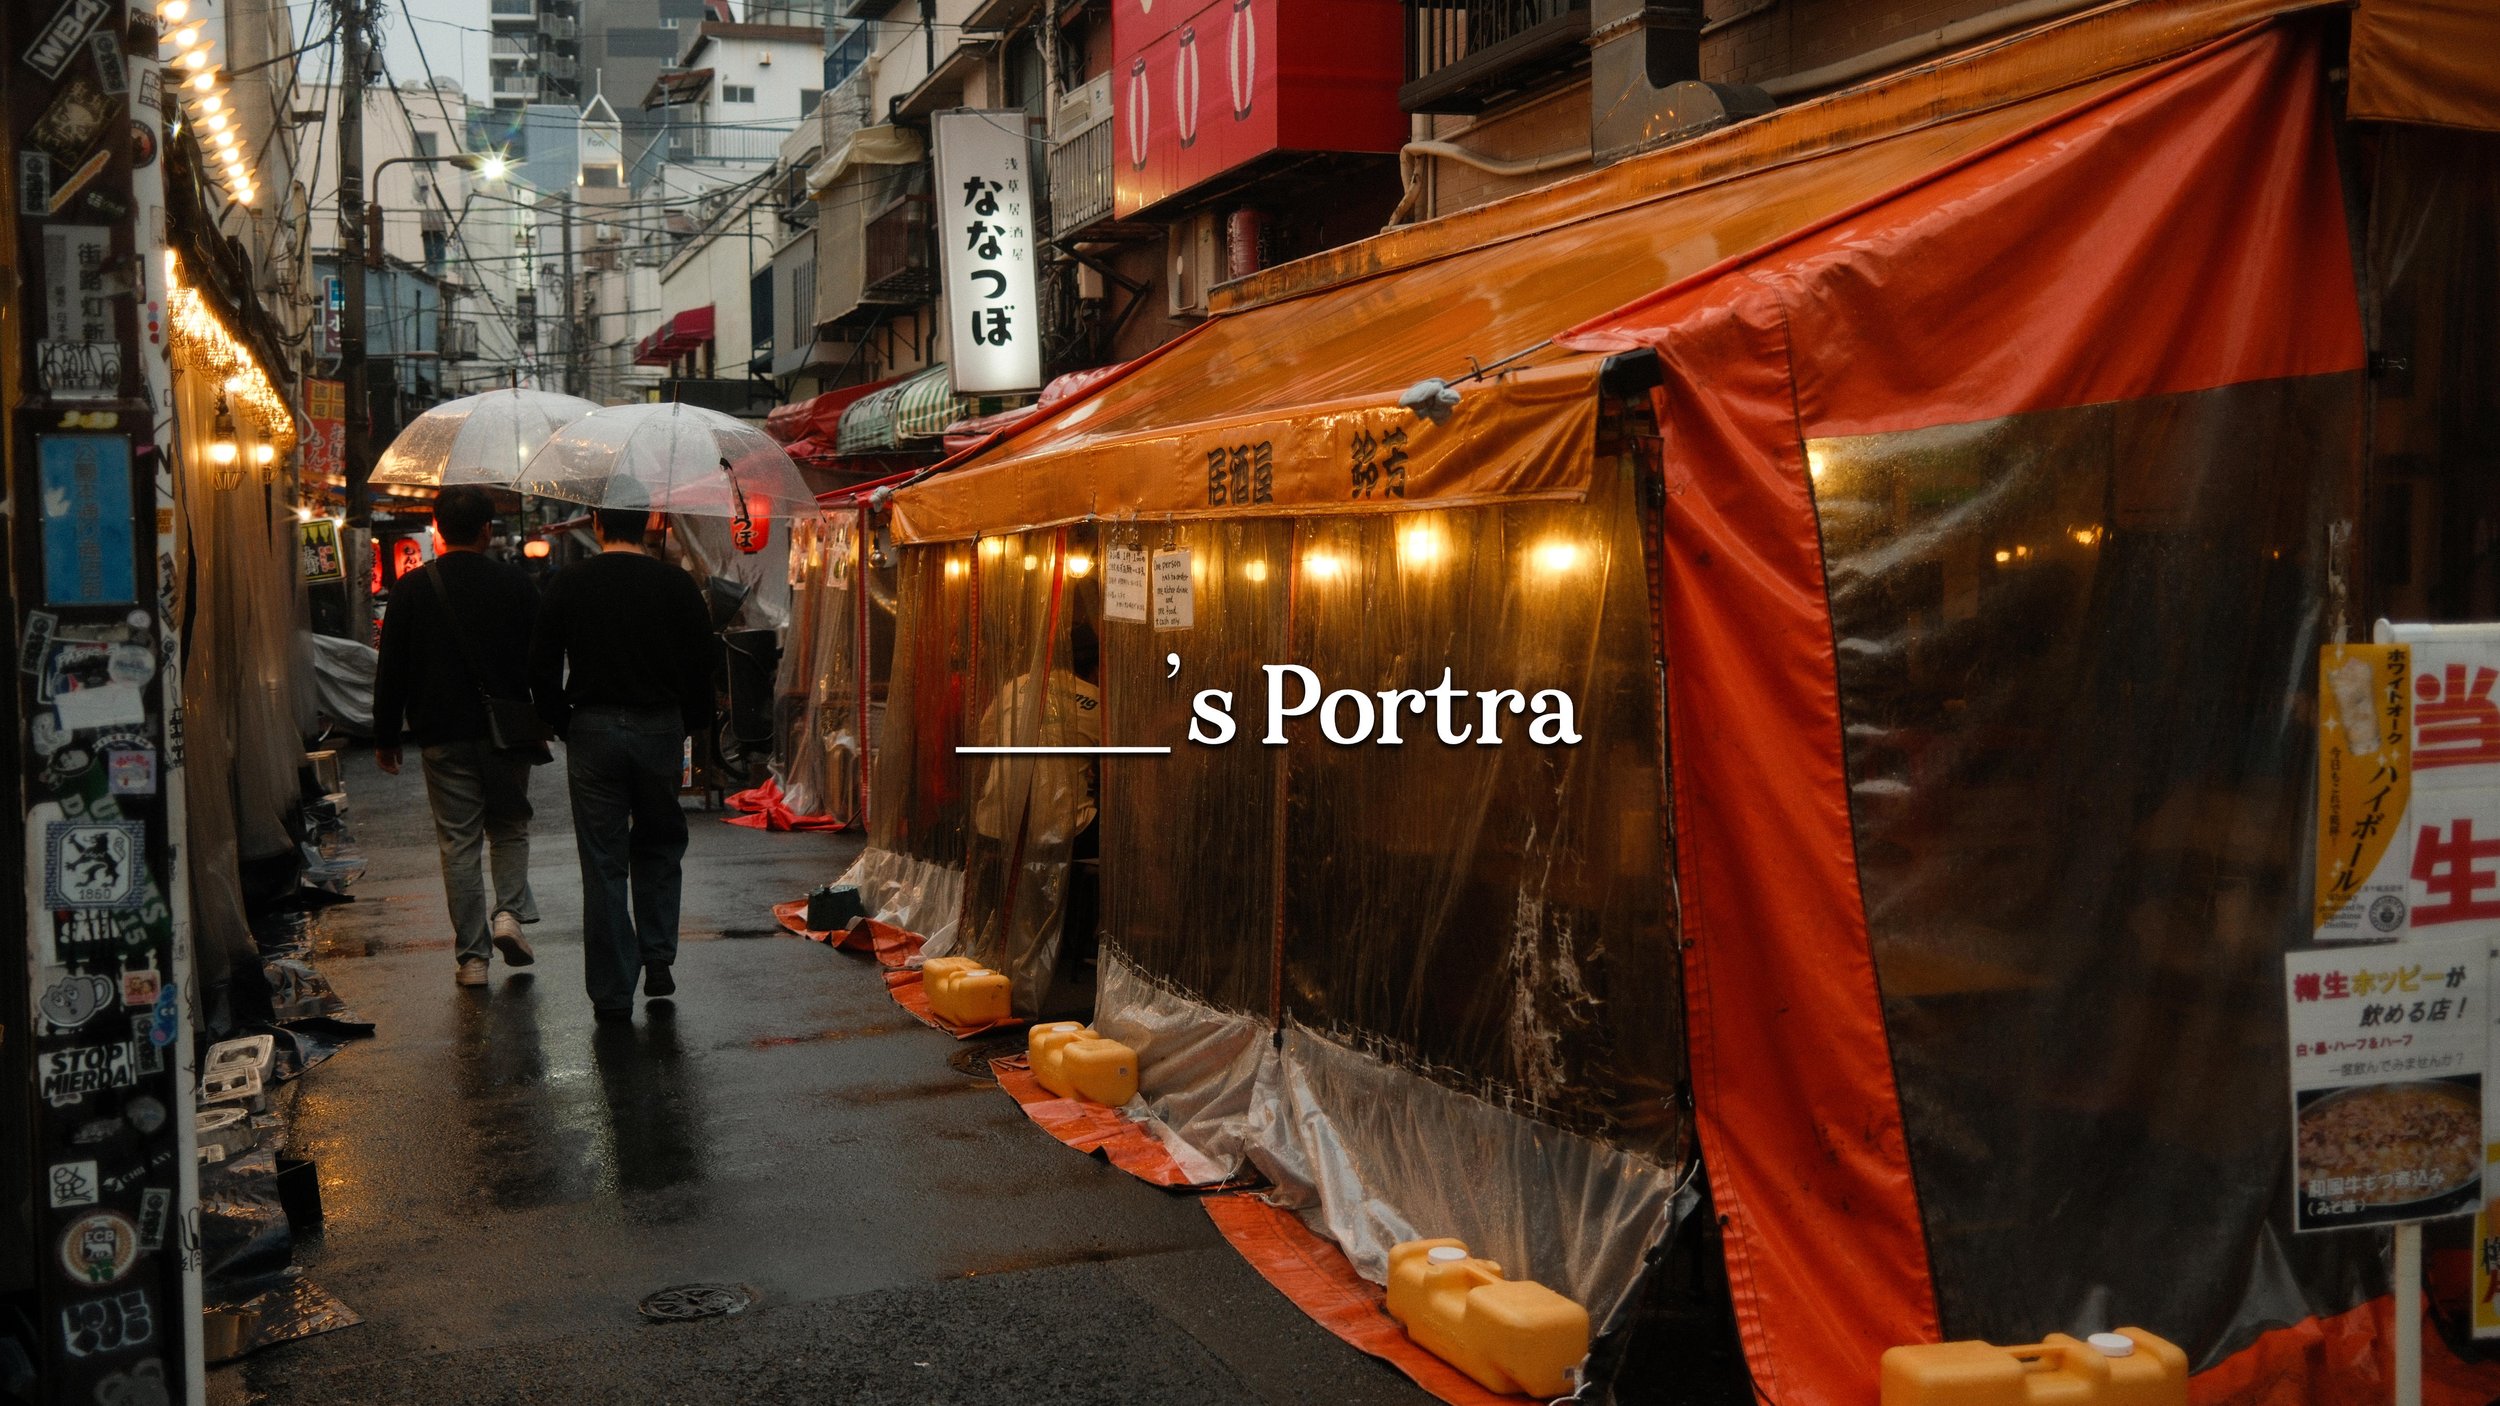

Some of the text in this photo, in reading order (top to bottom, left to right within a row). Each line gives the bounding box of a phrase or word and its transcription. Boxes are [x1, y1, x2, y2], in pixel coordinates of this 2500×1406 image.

[1004, 157, 1024, 262] 浅草居酒屋
[963, 175, 1016, 347] ななつぼ
[1207, 440, 1274, 506] 居酒屋
[2386, 649, 2406, 745] ホワイトオーク
[2330, 765, 2398, 892] ハイボール
[79, 888, 111, 900] 1860
[2294, 964, 2467, 1003] 樽生ホッピーが
[43, 1065, 129, 1097] MIERDA
[51, 1043, 123, 1074] STOP
